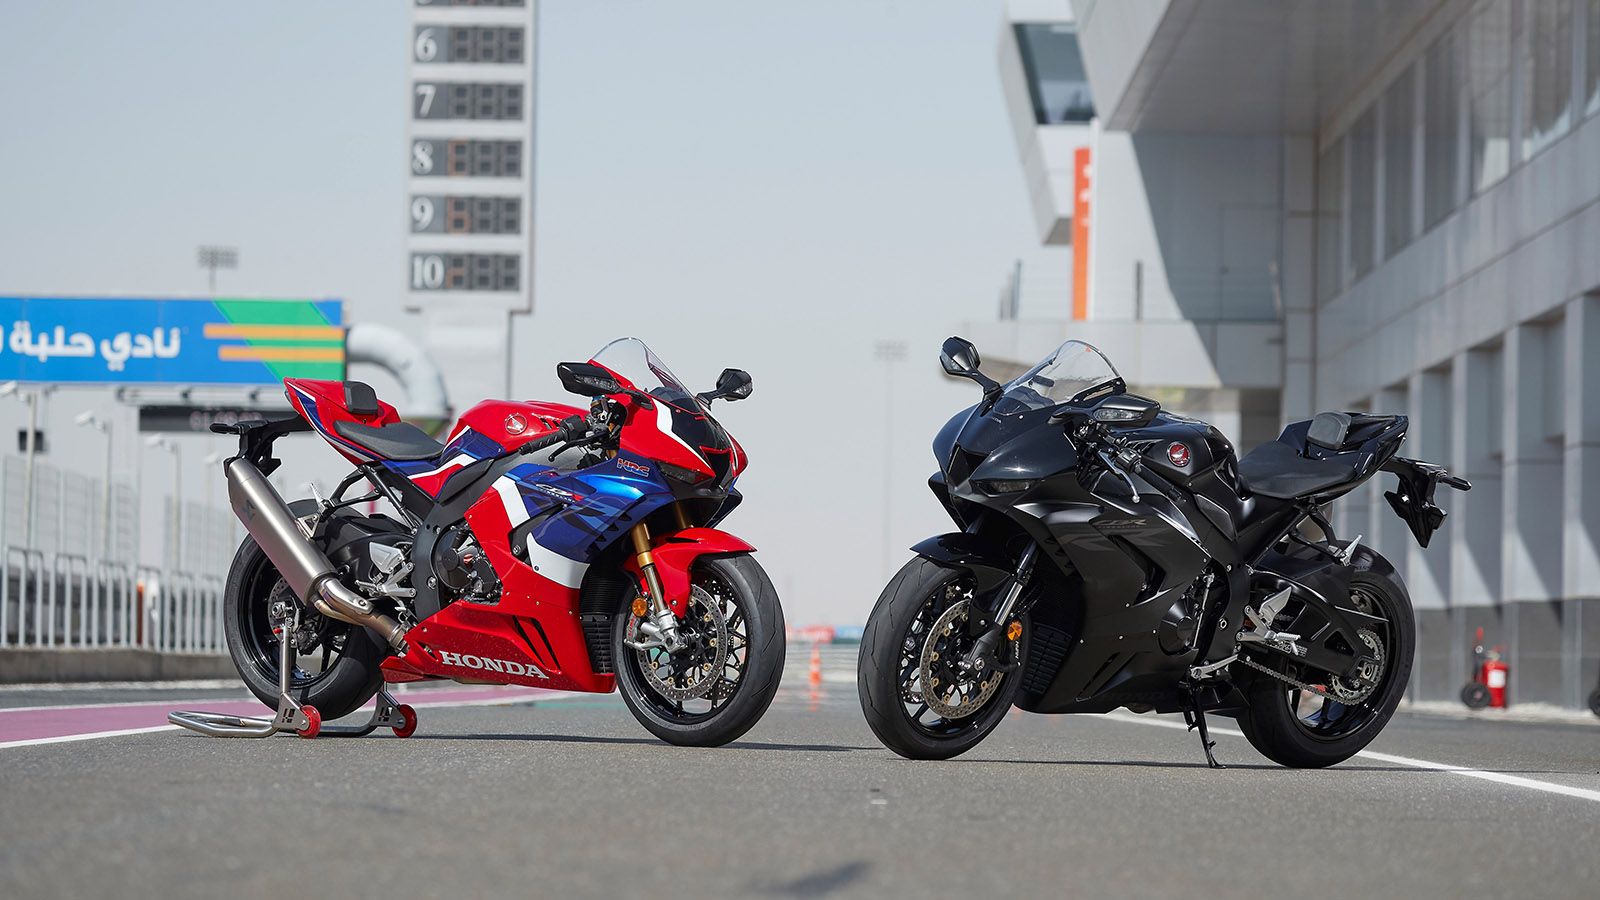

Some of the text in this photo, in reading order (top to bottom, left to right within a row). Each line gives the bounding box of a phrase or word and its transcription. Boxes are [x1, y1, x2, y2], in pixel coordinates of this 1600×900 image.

[415, 28, 437, 61] 6
[415, 84, 437, 117] 7
[412, 141, 433, 174] 8
[412, 196, 434, 231] 9
[412, 255, 444, 289] 10
[9, 320, 96, 362] حلبة
[101, 327, 181, 371] نادي
[439, 650, 549, 679] HONDA
